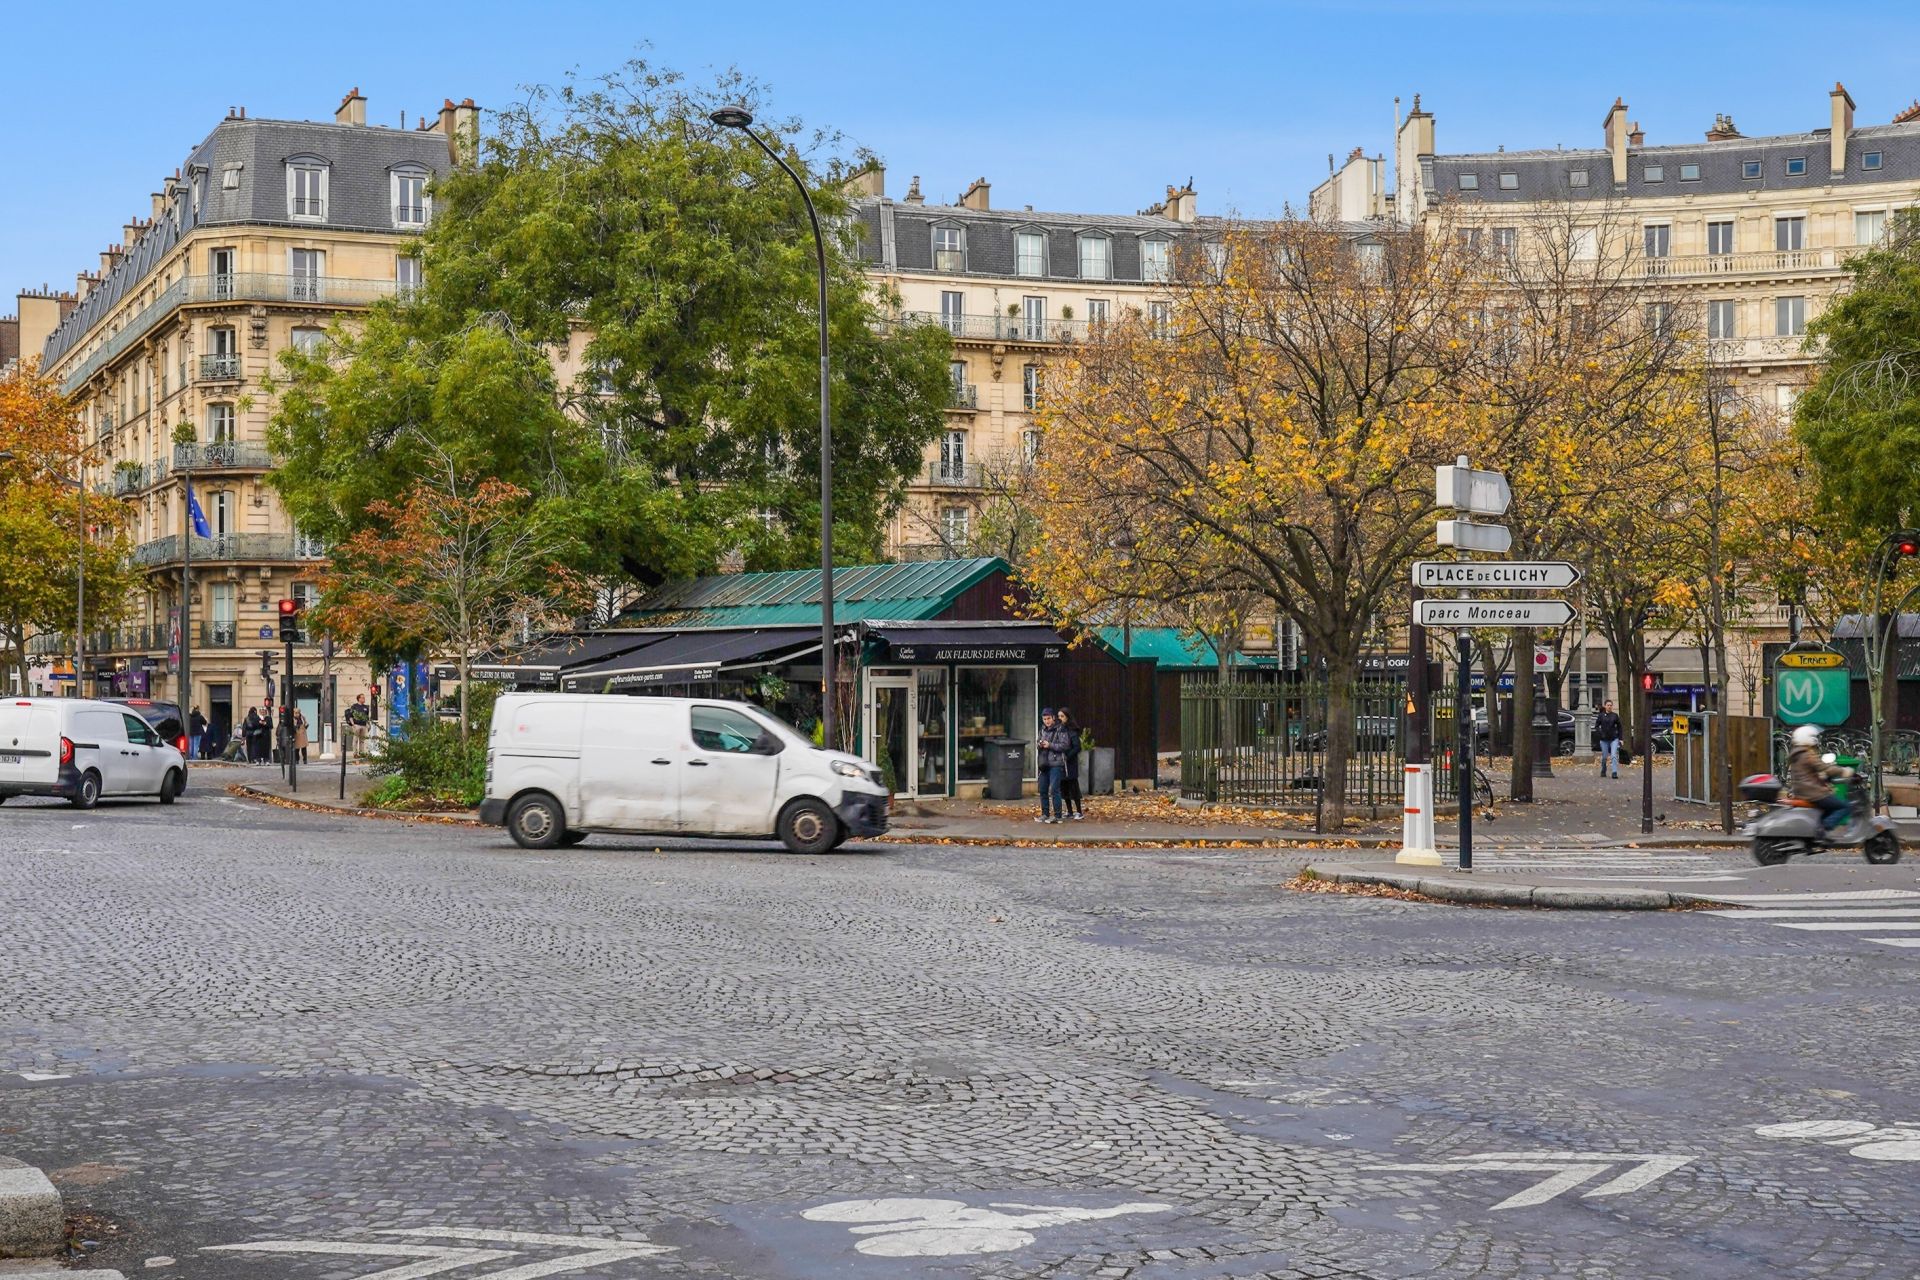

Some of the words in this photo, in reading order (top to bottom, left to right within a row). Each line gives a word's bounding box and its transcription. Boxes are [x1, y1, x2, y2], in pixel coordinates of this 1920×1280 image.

[1426, 569, 1474, 581] PLACE
[1478, 573, 1490, 581] DE
[1494, 569, 1549, 581] CLICHY
[1428, 608, 1460, 621] parc
[1468, 606, 1531, 619] Monceau
[936, 650, 953, 660] AUX
[953, 650, 983, 659] FLEURS
[983, 650, 995, 659] DE
[995, 649, 1026, 659] FRANCE
[1785, 678, 1812, 705] M
